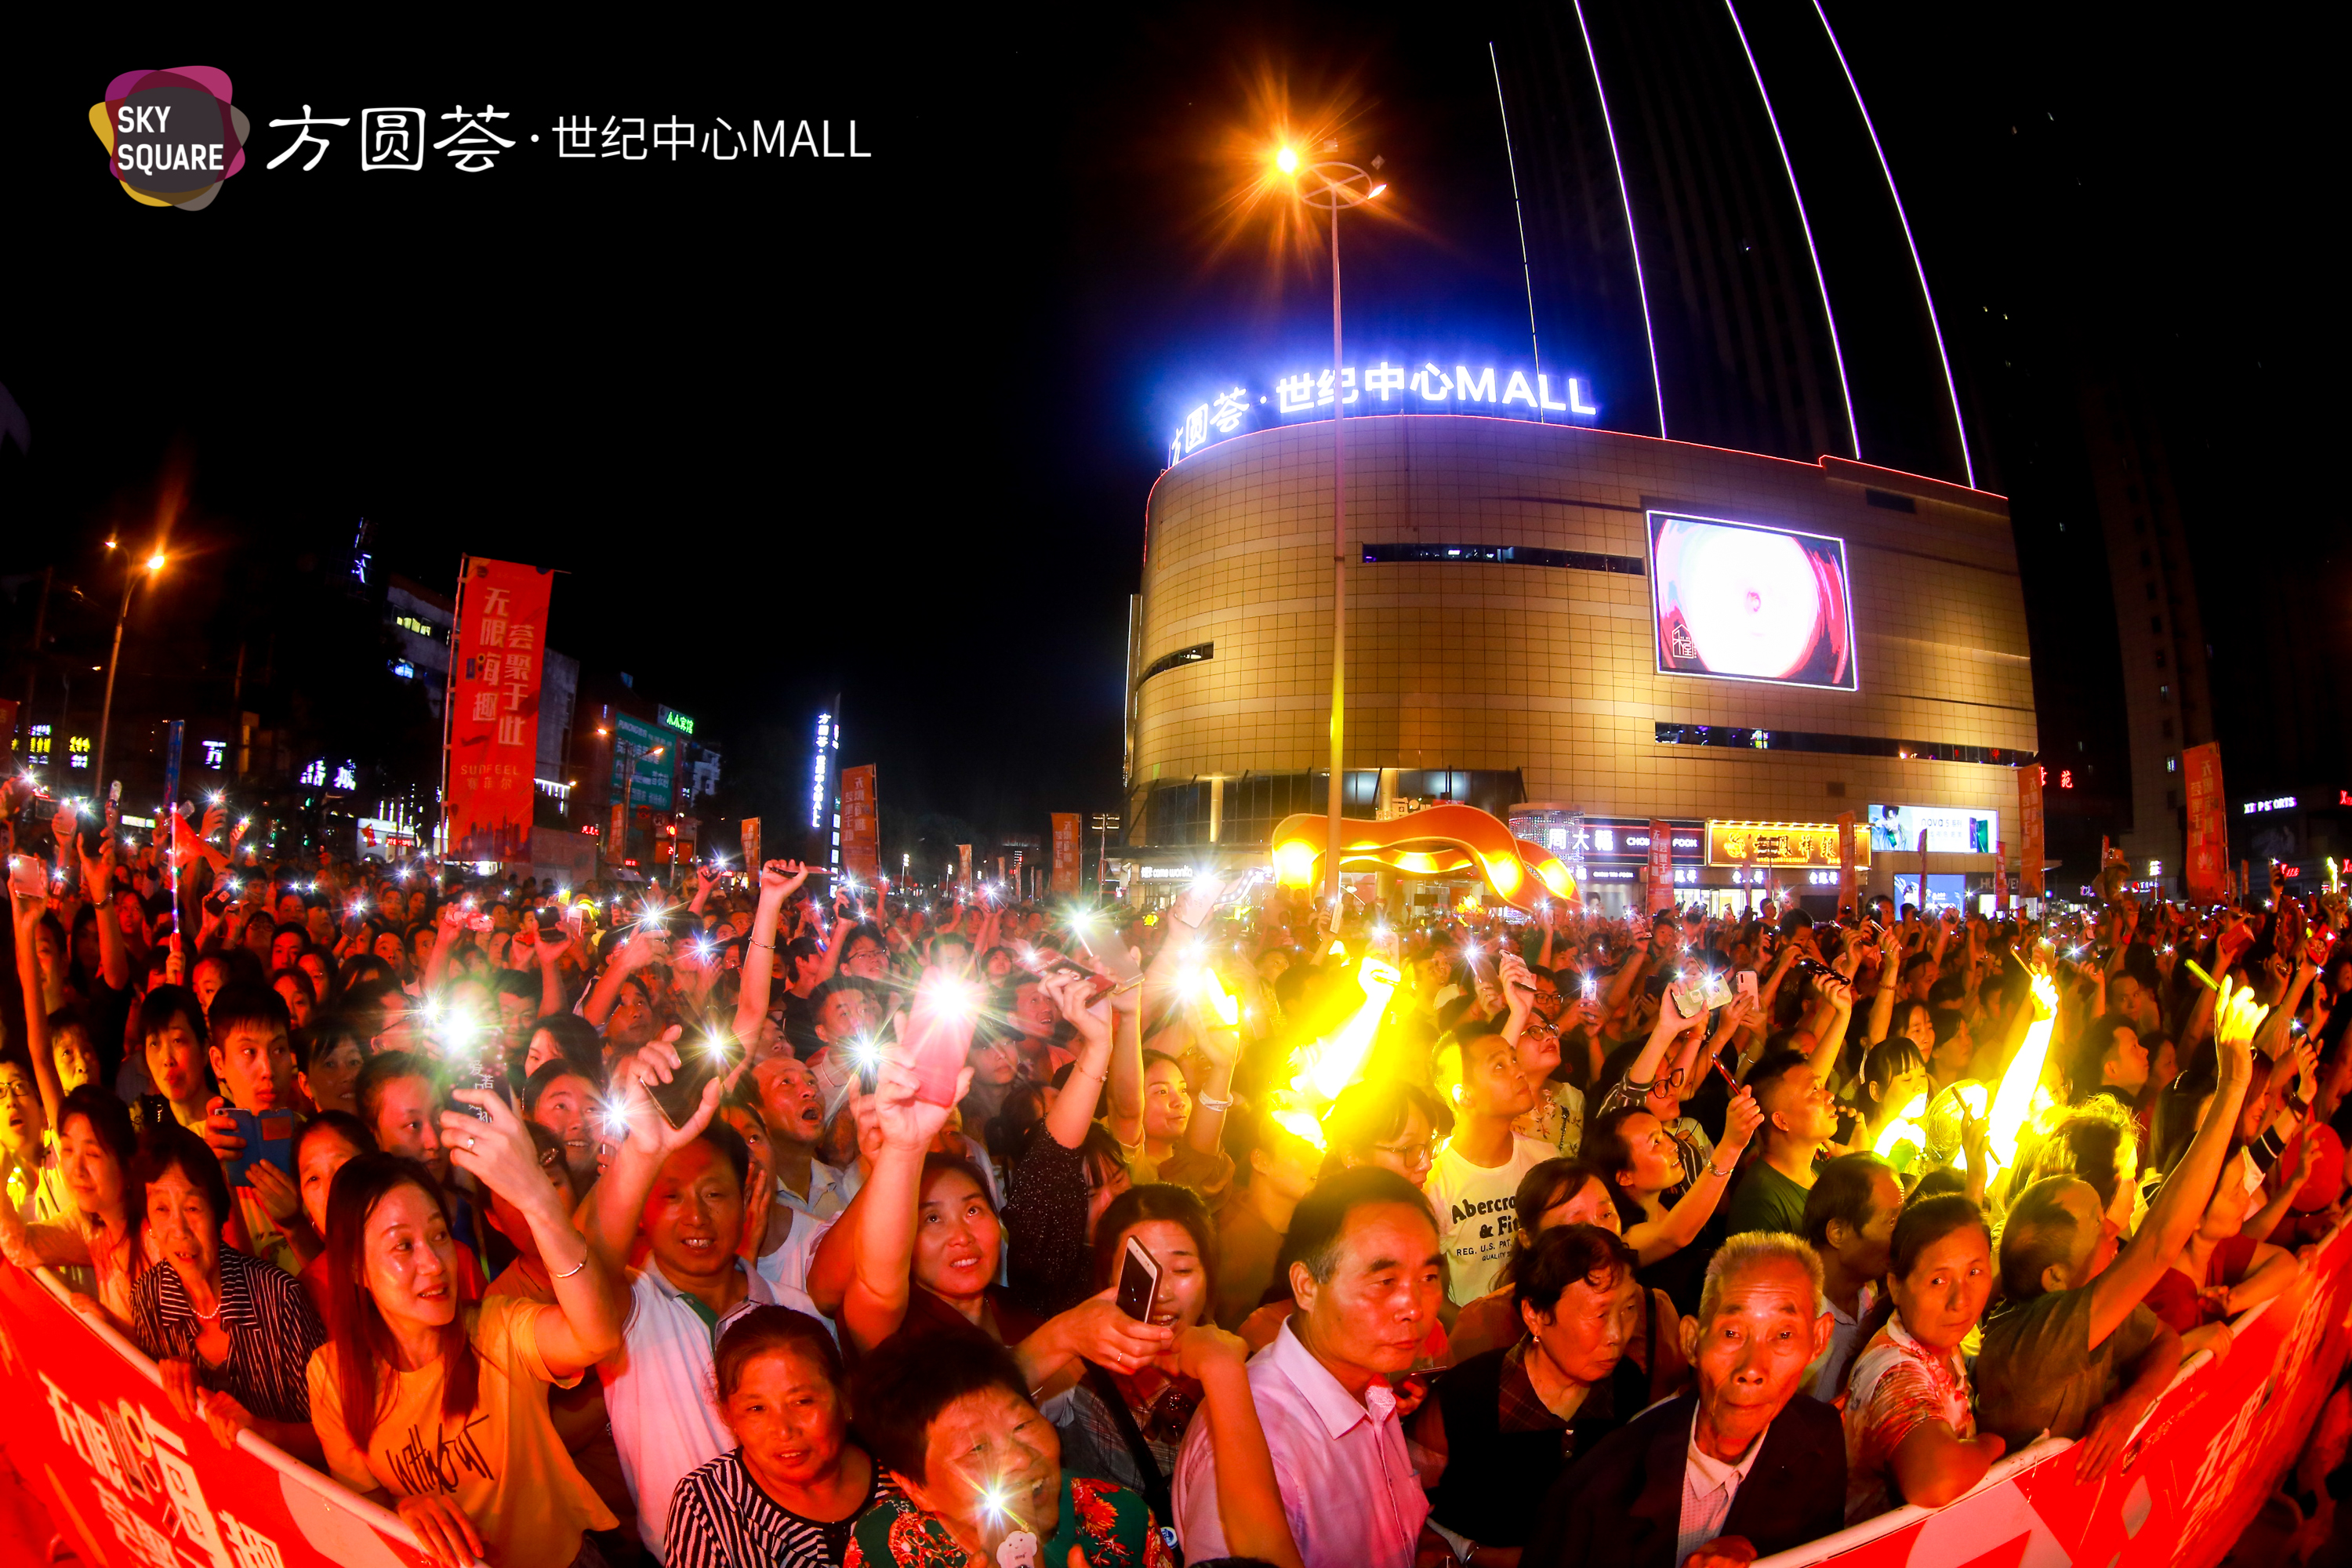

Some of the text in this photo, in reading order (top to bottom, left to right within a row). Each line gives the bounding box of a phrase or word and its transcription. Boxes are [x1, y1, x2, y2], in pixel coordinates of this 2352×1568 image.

[498, 625, 535, 746] 荟聚于此
[1921, 818, 1944, 827] nova
[1548, 828, 1614, 852] 周大福
[1672, 837, 1697, 848] FOOK
[1451, 1196, 1517, 1225] Abercro
[1479, 1215, 1519, 1239] & Fit
[1457, 1239, 1512, 1257] REG. U.S. PAT.
[1482, 1252, 1507, 1261] QUALITY
